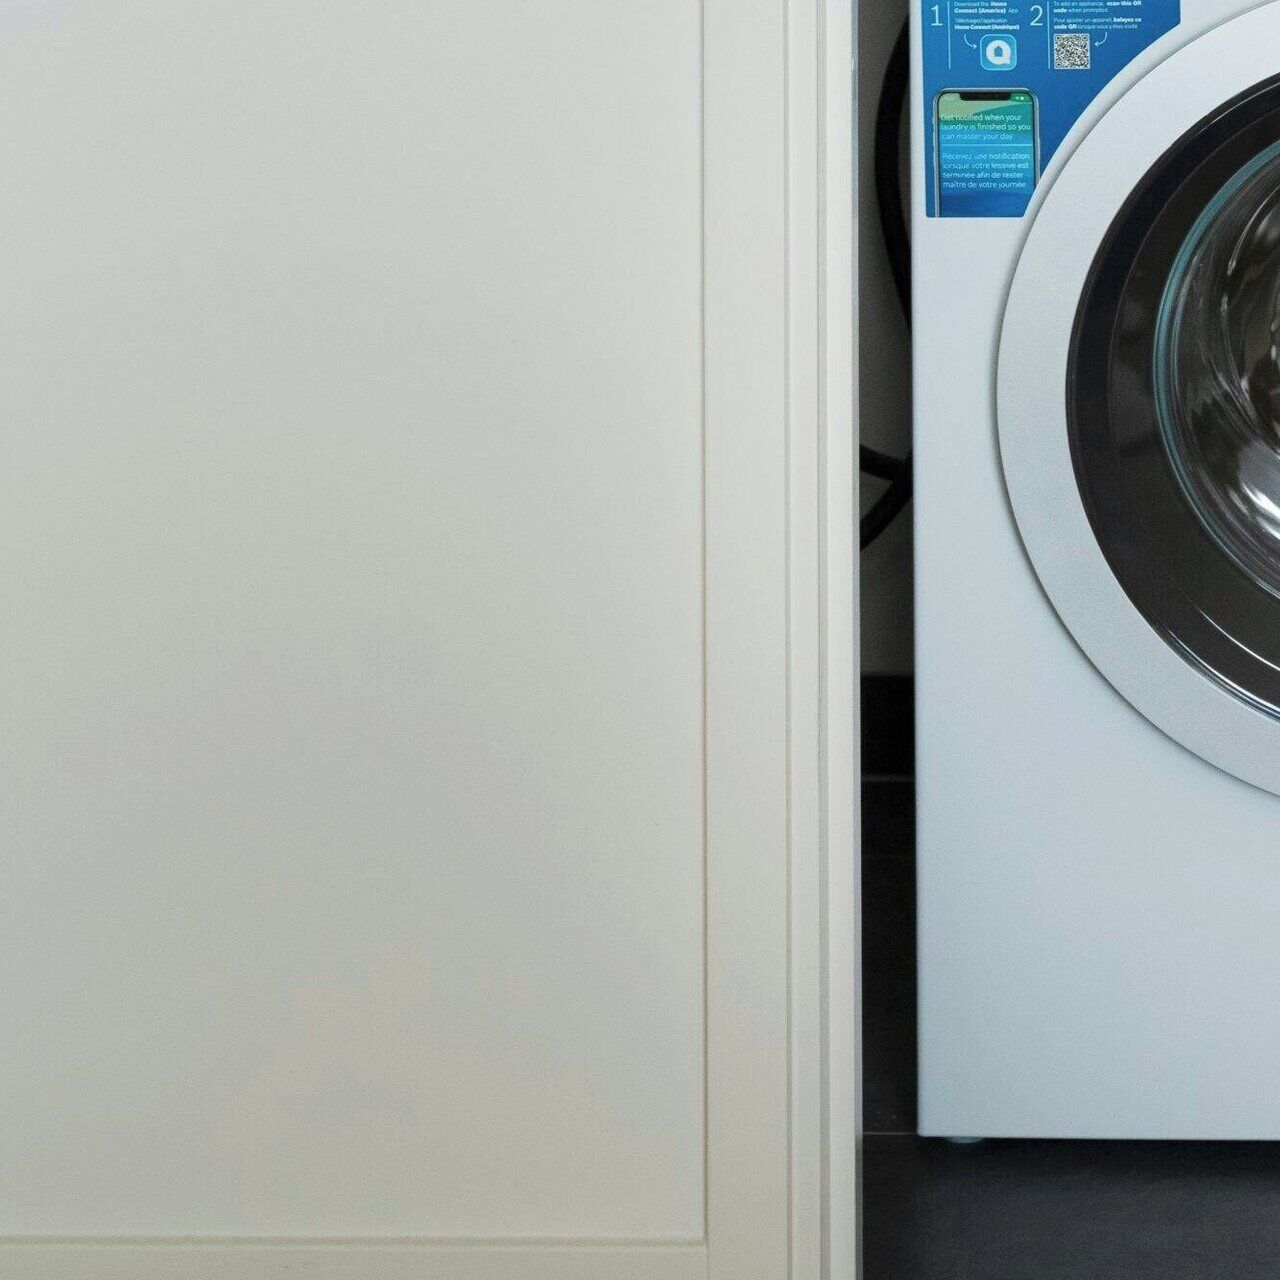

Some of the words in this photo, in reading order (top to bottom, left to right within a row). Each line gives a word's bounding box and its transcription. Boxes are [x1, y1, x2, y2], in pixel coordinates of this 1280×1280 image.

[931, 4, 943, 26] 1
[1030, 5, 1043, 26] 2
[977, 123, 1007, 131] finished
[982, 133, 998, 141] your
[988, 152, 1030, 160] notification
[943, 162, 970, 171] lorsque
[976, 171, 990, 179] afin
[991, 171, 1001, 179] de
[968, 180, 978, 188] de
